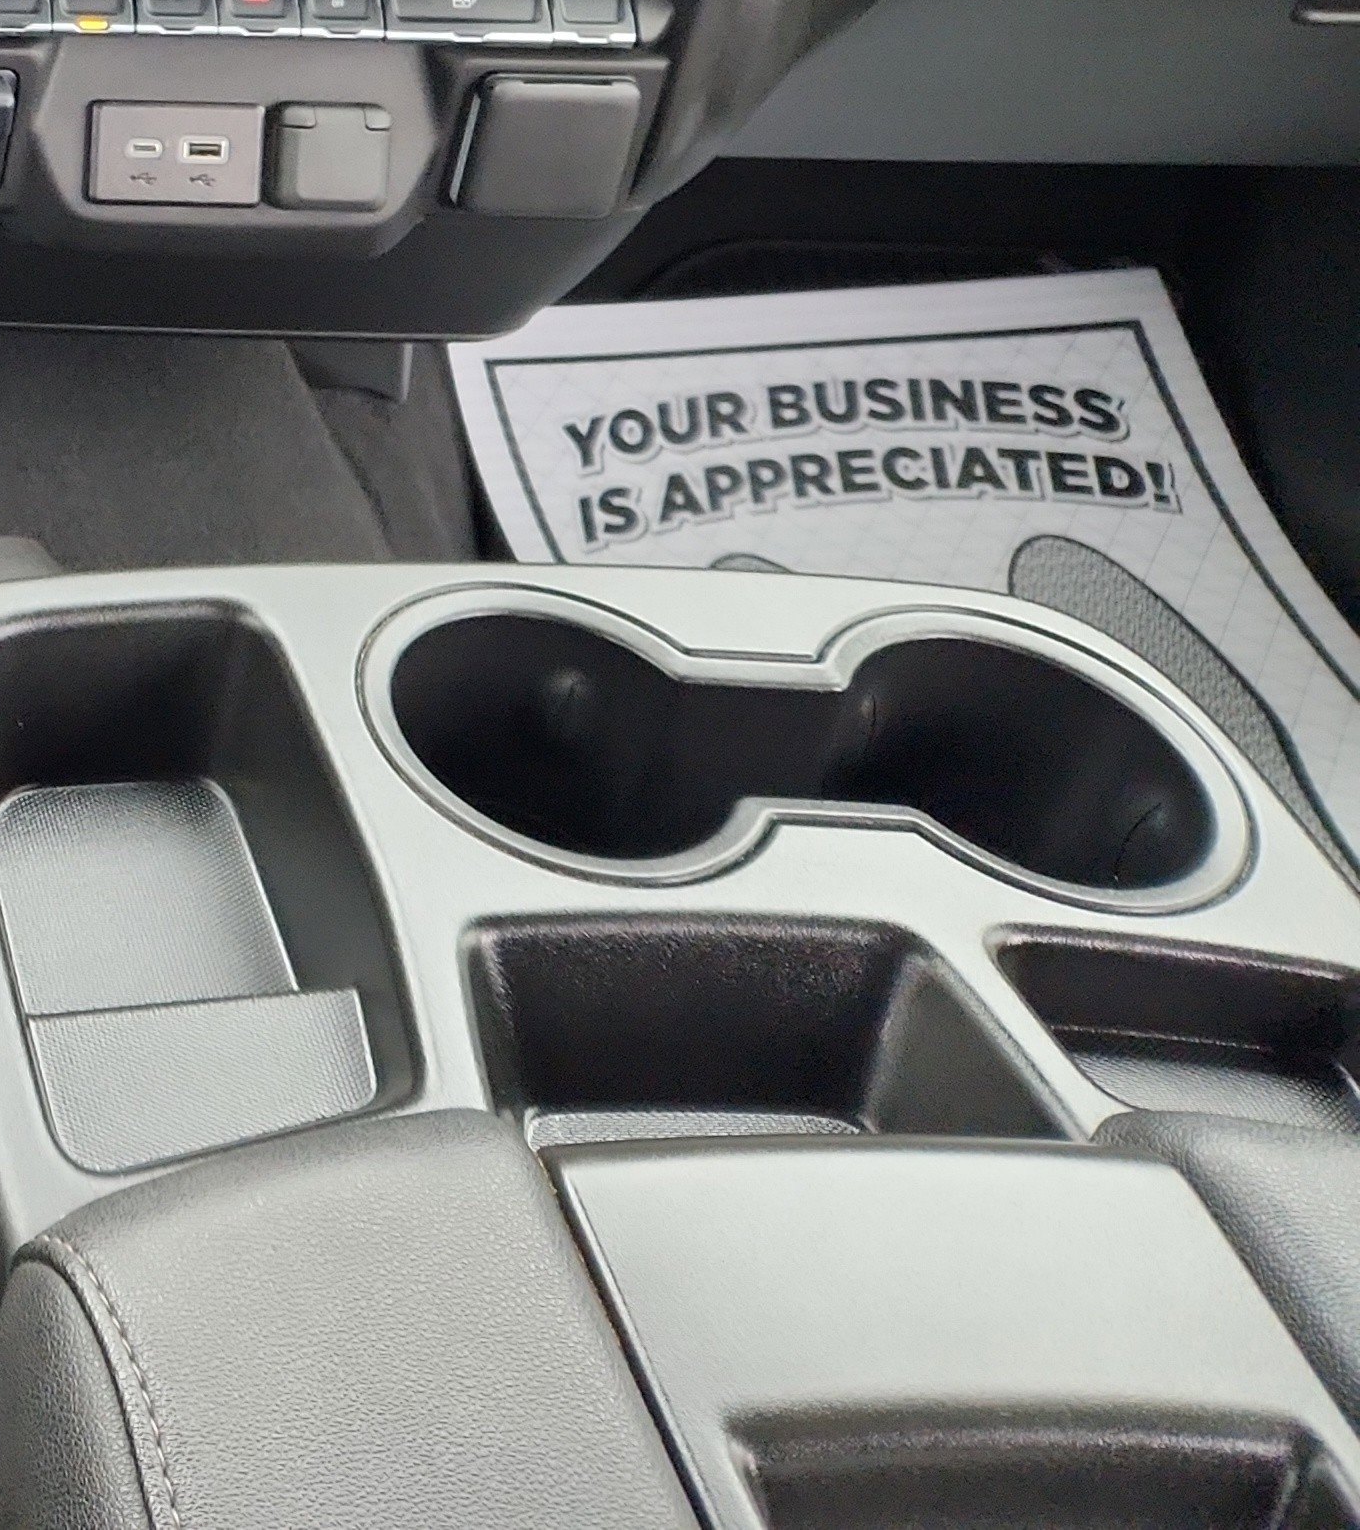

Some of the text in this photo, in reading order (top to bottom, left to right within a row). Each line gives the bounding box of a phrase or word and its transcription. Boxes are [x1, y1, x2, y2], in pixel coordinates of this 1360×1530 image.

[564, 377, 1124, 468] YOUR BUSINESS
[579, 446, 1174, 544] IS APPRECIATED!
